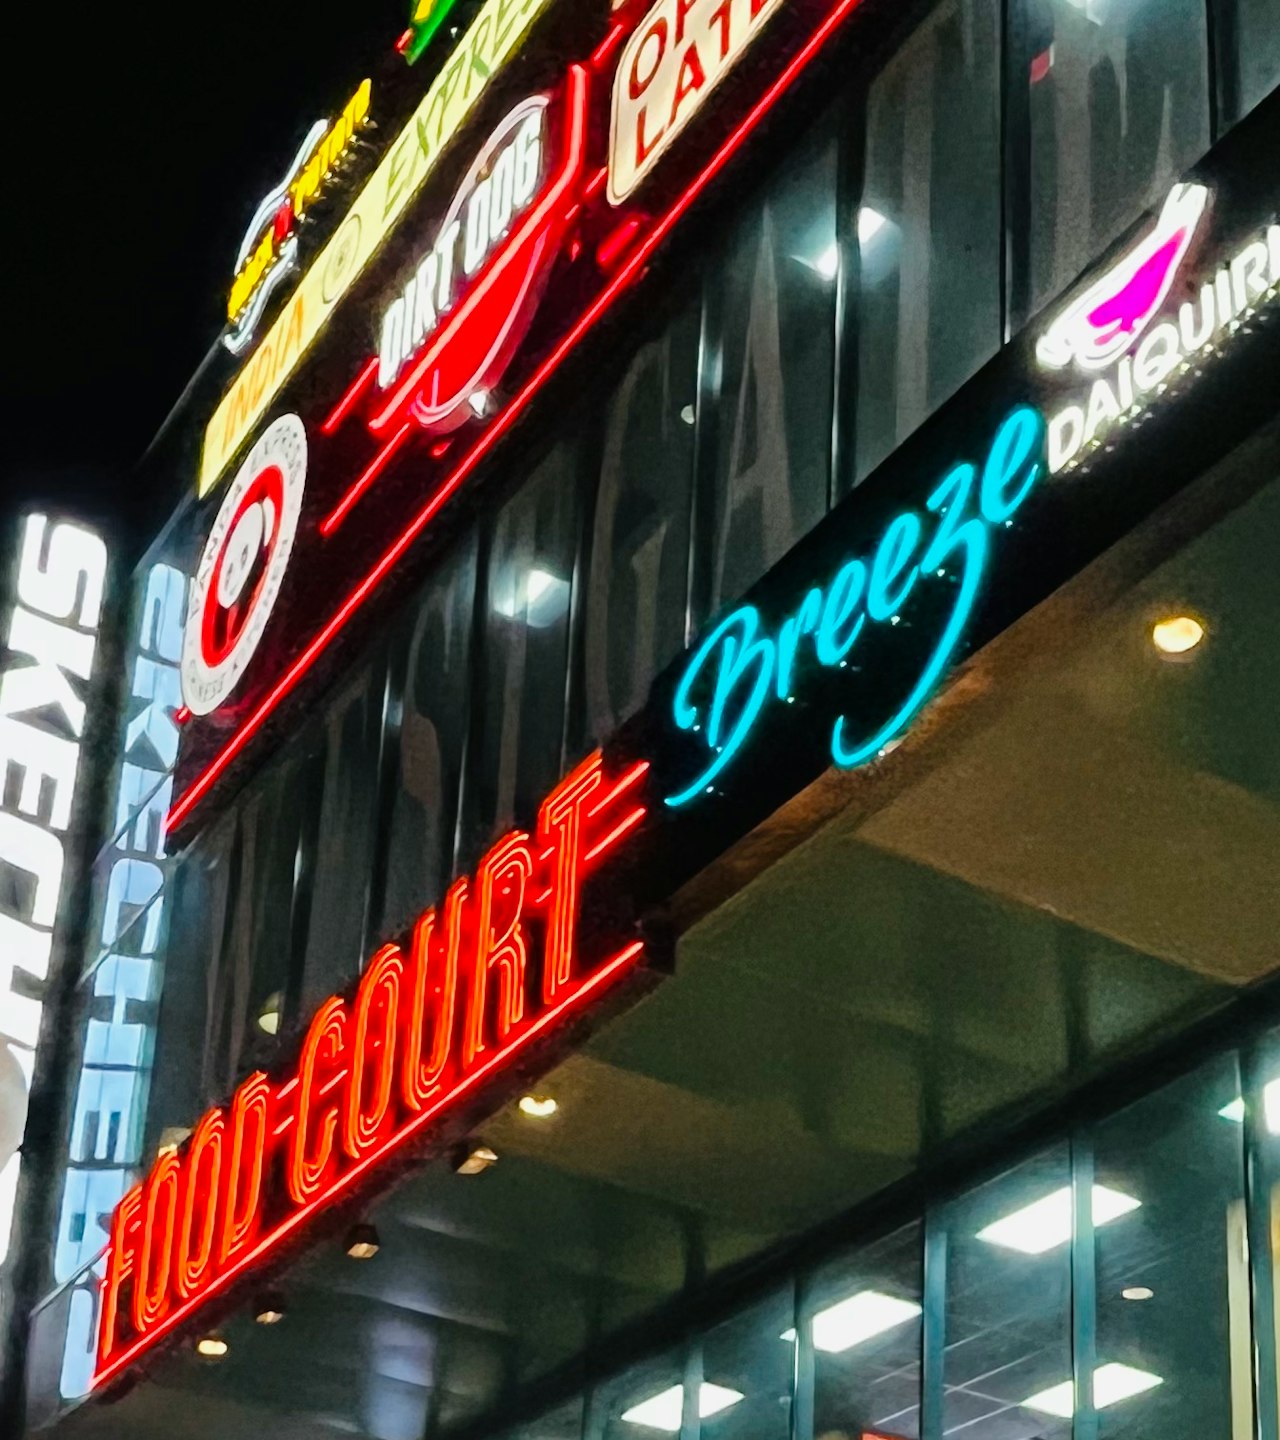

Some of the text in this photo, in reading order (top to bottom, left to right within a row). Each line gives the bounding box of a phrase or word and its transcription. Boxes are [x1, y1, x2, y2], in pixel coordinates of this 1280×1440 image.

[382, 0, 532, 220] EXPRE
[635, 0, 770, 171] LAT
[378, 107, 542, 391] DIRT DOG
[665, 405, 1044, 806] Breeze
[98, 748, 603, 1358] FOOD COURT
